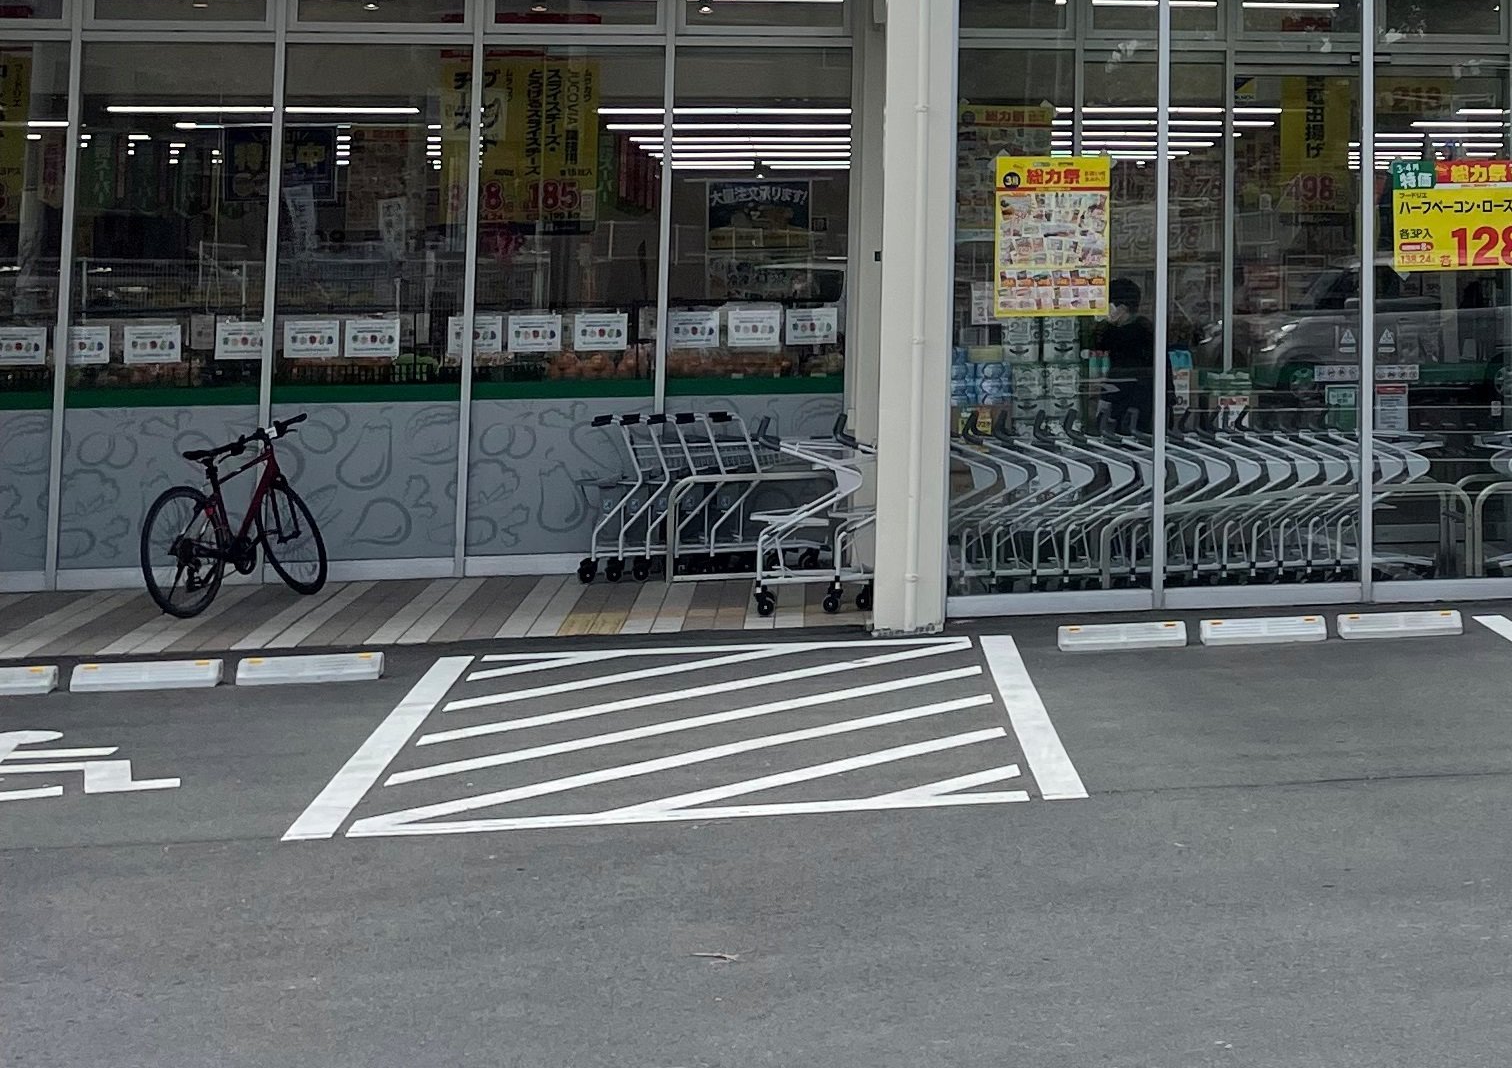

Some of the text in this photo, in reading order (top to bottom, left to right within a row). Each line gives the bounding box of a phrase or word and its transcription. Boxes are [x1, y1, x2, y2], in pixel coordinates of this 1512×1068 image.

[1027, 168, 1081, 185] 総力祭
[1400, 172, 1433, 189] 特価
[1450, 164, 1507, 183] 総力祭
[527, 179, 581, 213] 185
